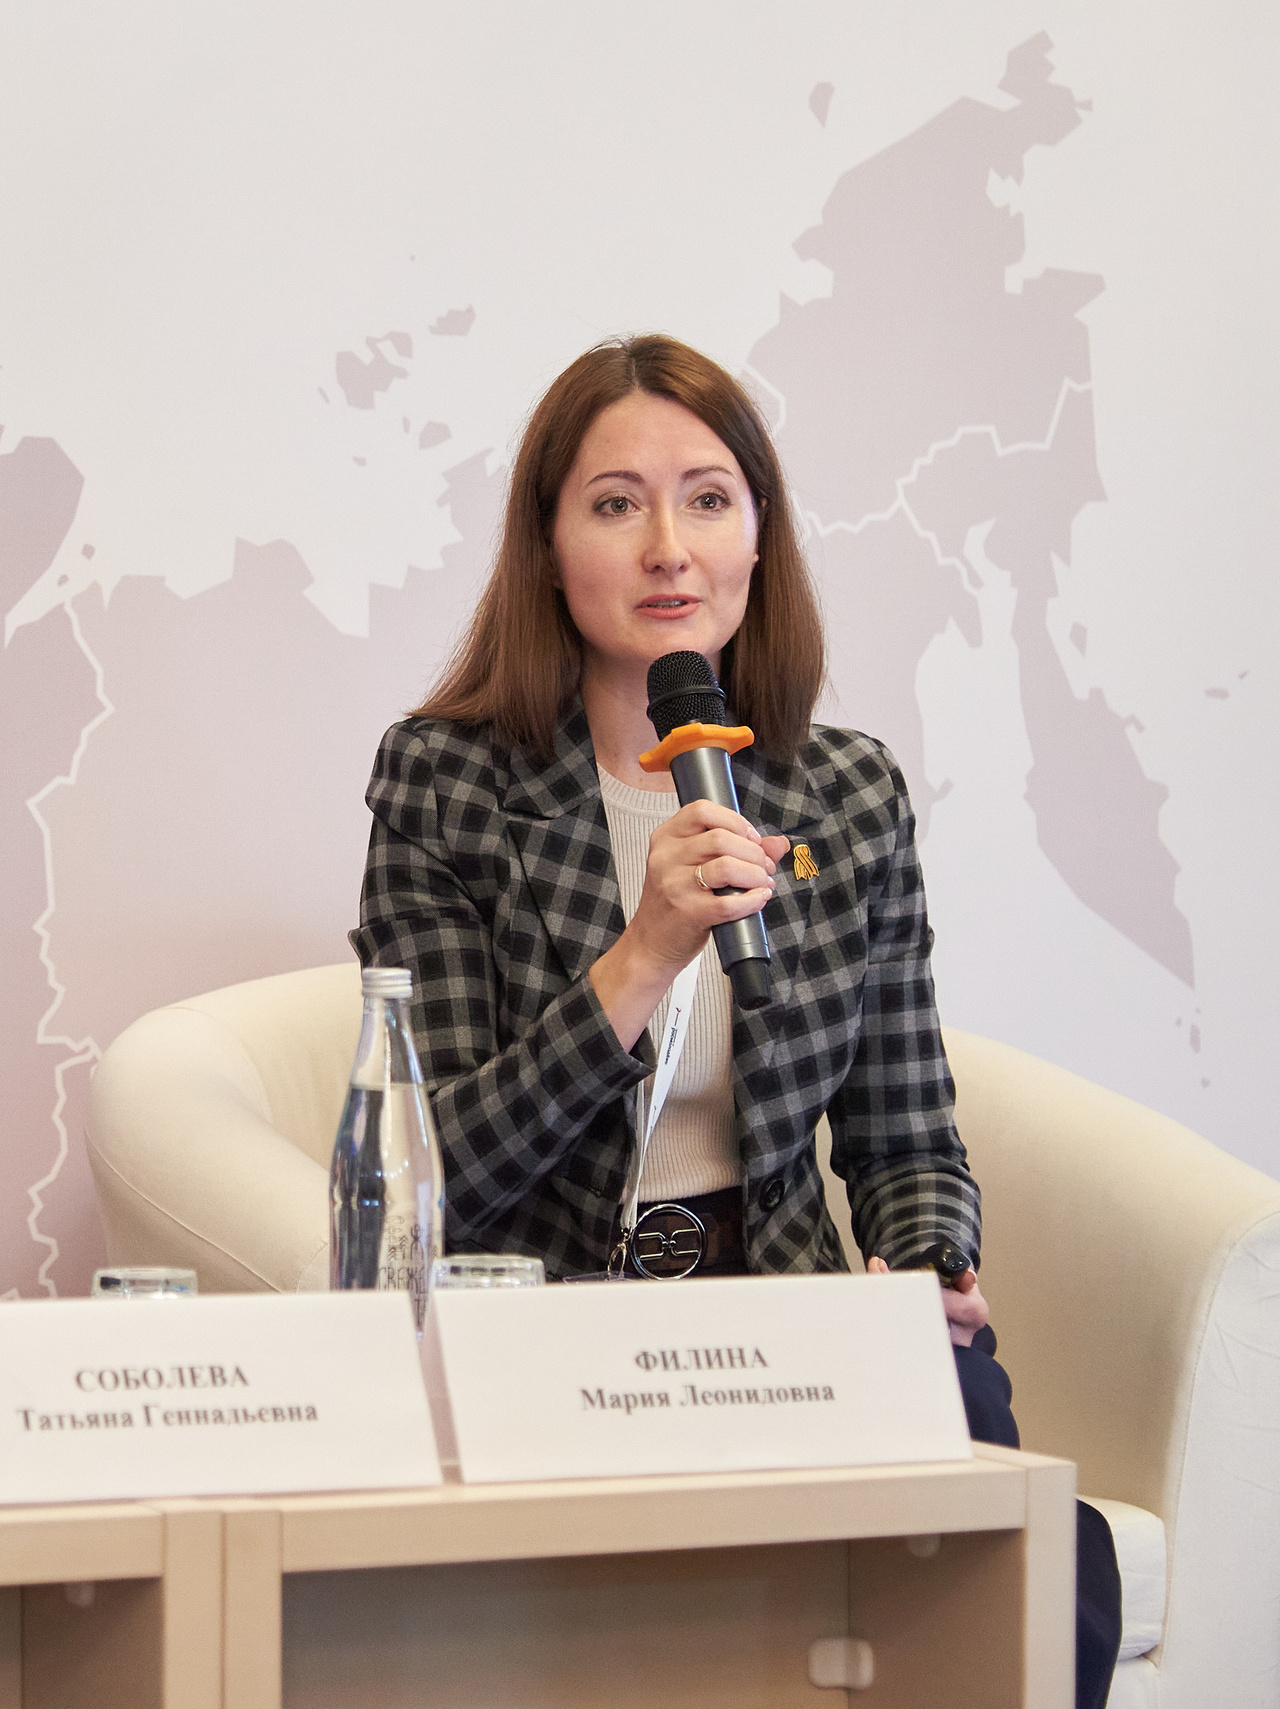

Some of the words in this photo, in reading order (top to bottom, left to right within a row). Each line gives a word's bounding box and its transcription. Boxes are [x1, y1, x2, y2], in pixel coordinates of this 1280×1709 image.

[634, 1347, 770, 1372] ФИЛИНА
[75, 1365, 250, 1392] СОБОЛЕВА
[580, 1387, 671, 1416] Мария
[679, 1383, 837, 1407] Леонидовна
[17, 1408, 134, 1432] Татьяна
[142, 1403, 319, 1428] Геннадьевна
